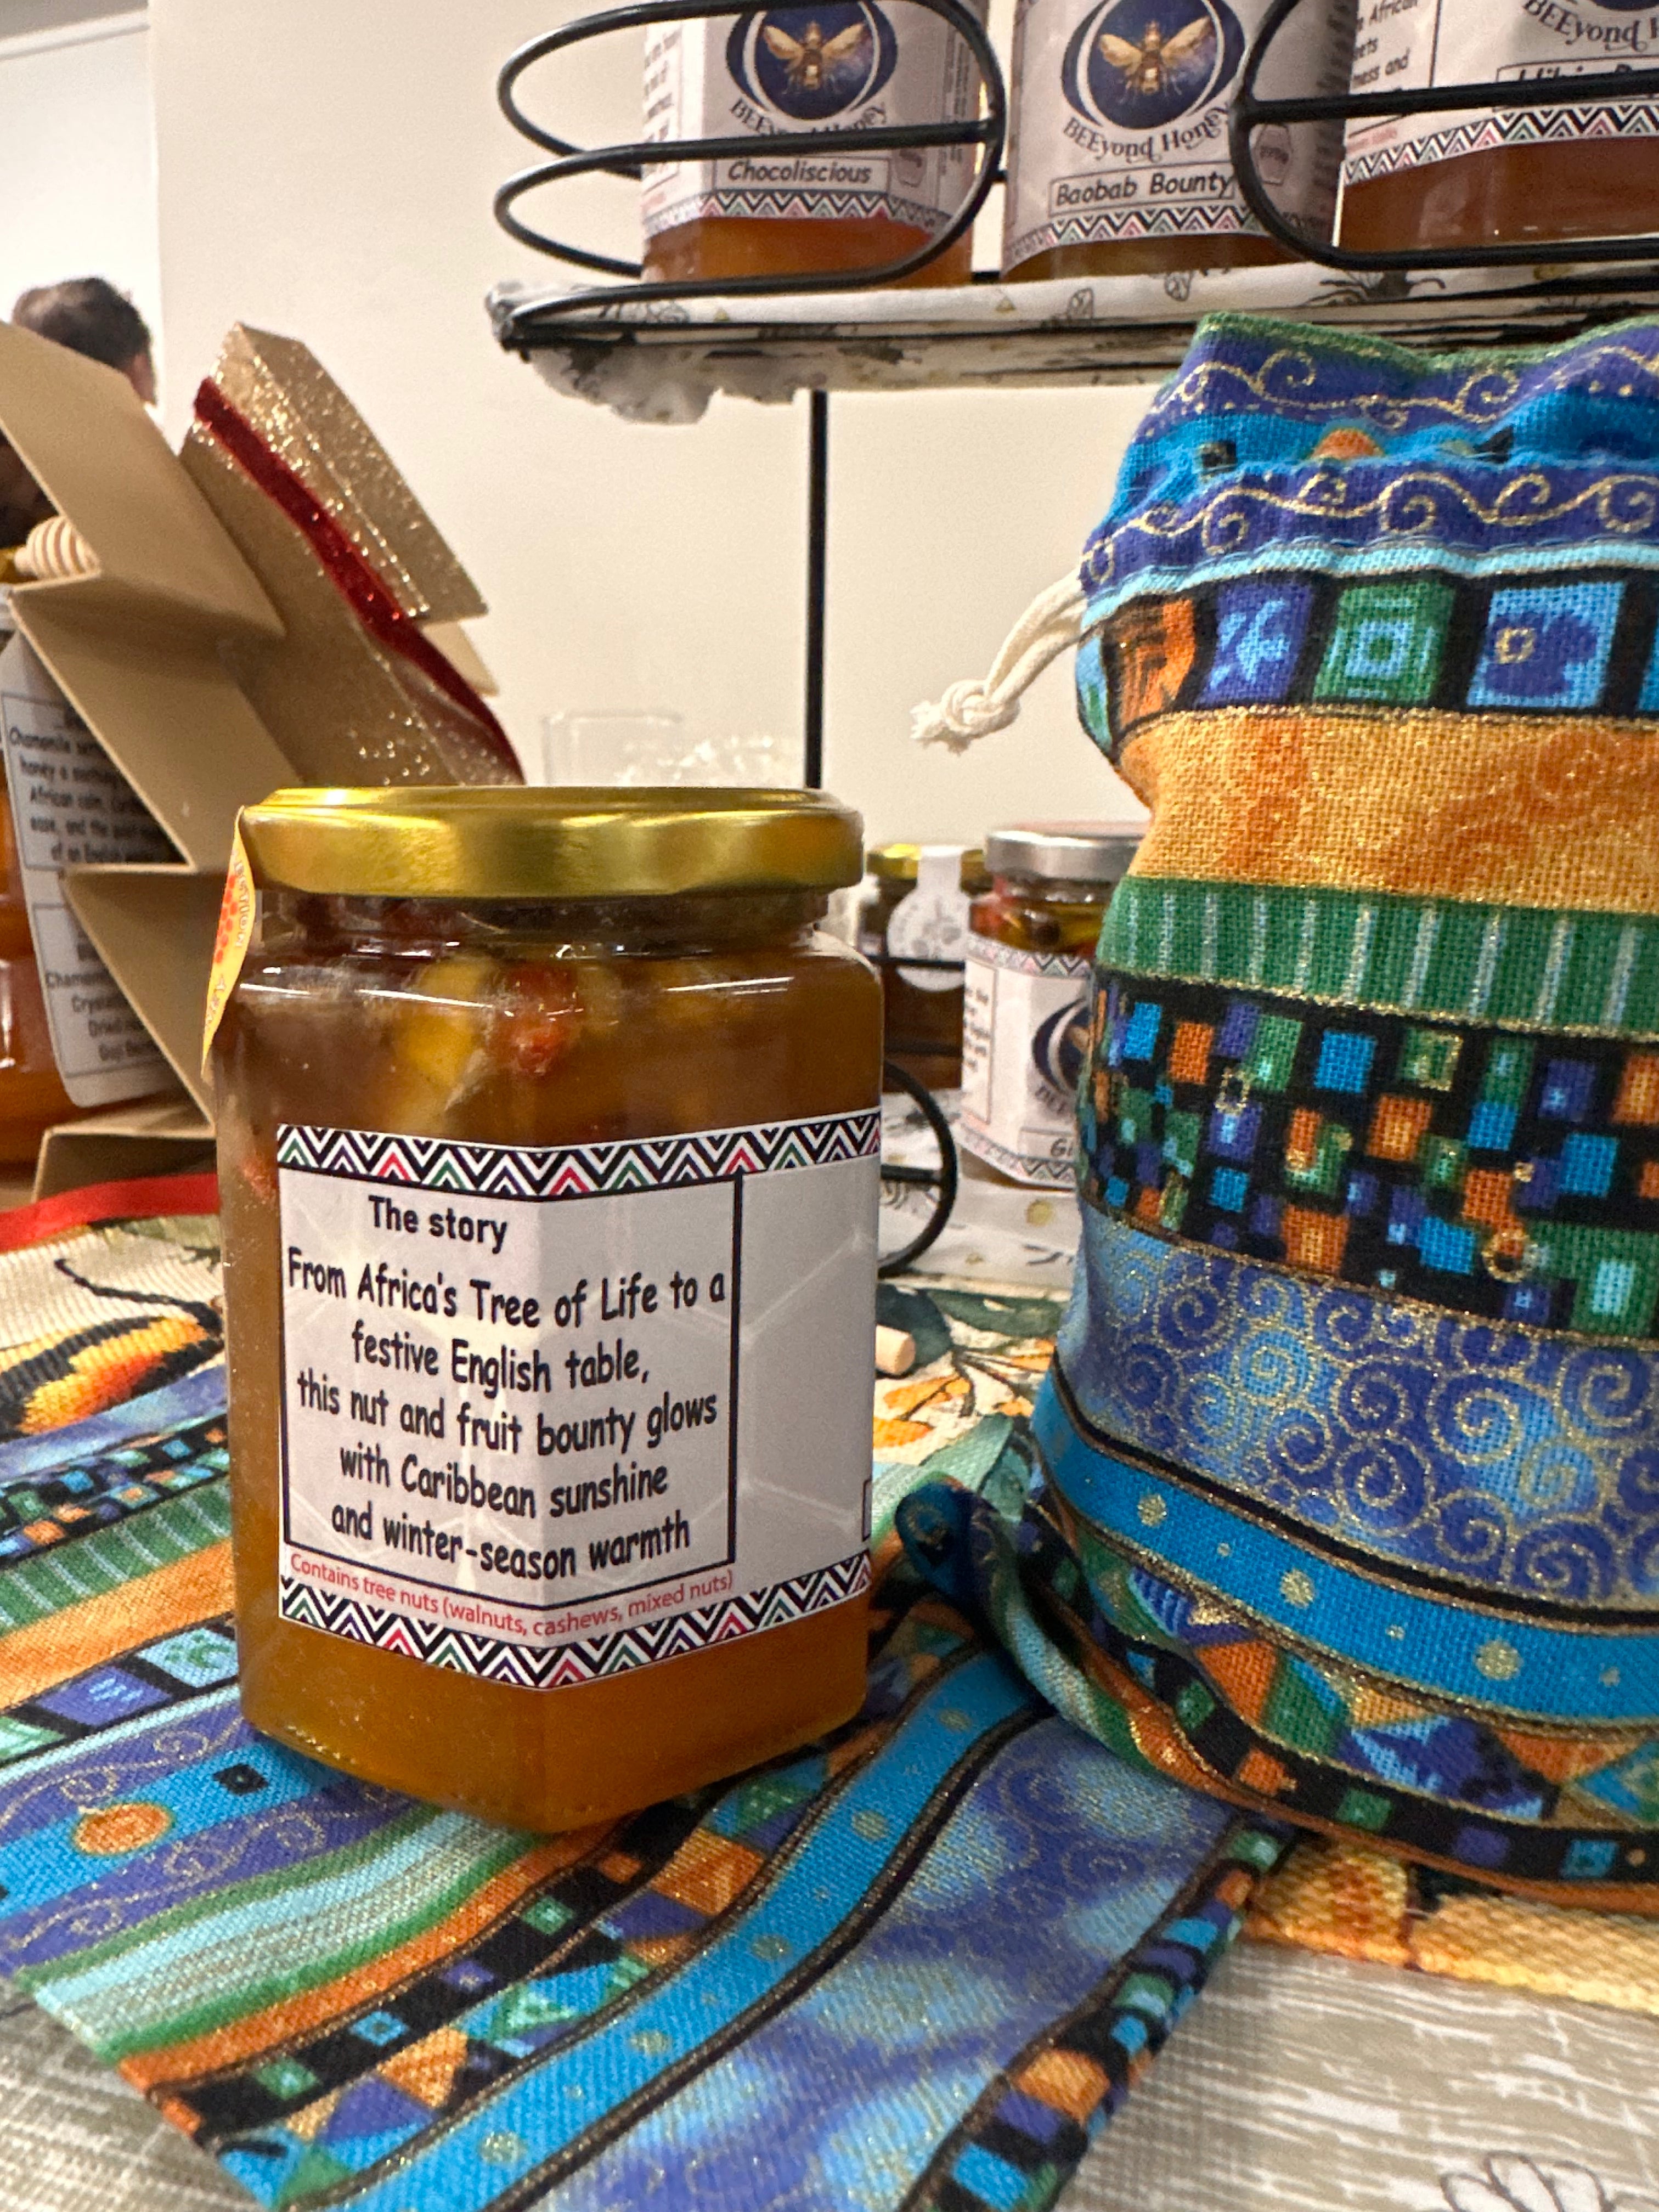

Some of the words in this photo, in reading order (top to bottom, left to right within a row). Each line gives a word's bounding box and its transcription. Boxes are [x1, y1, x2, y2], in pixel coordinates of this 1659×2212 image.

[728, 158, 872, 184] Chocoliscious
[1063, 116, 1162, 163] BEEyond
[1056, 174, 1137, 206] Baobab
[1149, 171, 1234, 200] Bounty
[368, 1194, 419, 1233] The
[428, 1207, 508, 1254] story
[288, 1246, 347, 1299] From
[357, 1262, 457, 1317] Africa's
[470, 1278, 540, 1328] Tree
[554, 1278, 588, 1328] of
[601, 1271, 658, 1321] Life
[669, 1271, 698, 1309] to
[709, 1272, 725, 1302] a
[351, 1318, 440, 1376] festive
[452, 1338, 552, 1399] English
[564, 1338, 650, 1390] table,
[296, 1367, 340, 1415] this
[351, 1389, 389, 1427] nut
[400, 1397, 445, 1439] and
[456, 1401, 523, 1454] fruit
[537, 1406, 636, 1456] bounty
[646, 1391, 718, 1449] glows
[340, 1441, 391, 1488] with
[401, 1453, 536, 1519] Caribbean
[549, 1460, 668, 1518] sunshine
[331, 1500, 373, 1541] and
[383, 1512, 577, 1581] winter-season
[589, 1509, 690, 1571] warmth
[290, 1552, 360, 1593] Contains
[362, 1576, 396, 1602] tree
[399, 1592, 439, 1615] nuts
[442, 1596, 527, 1636] (walnuts,
[532, 1605, 623, 1636] cashews,
[627, 1582, 685, 1617] mixed
[689, 1568, 733, 1599] nuts)
